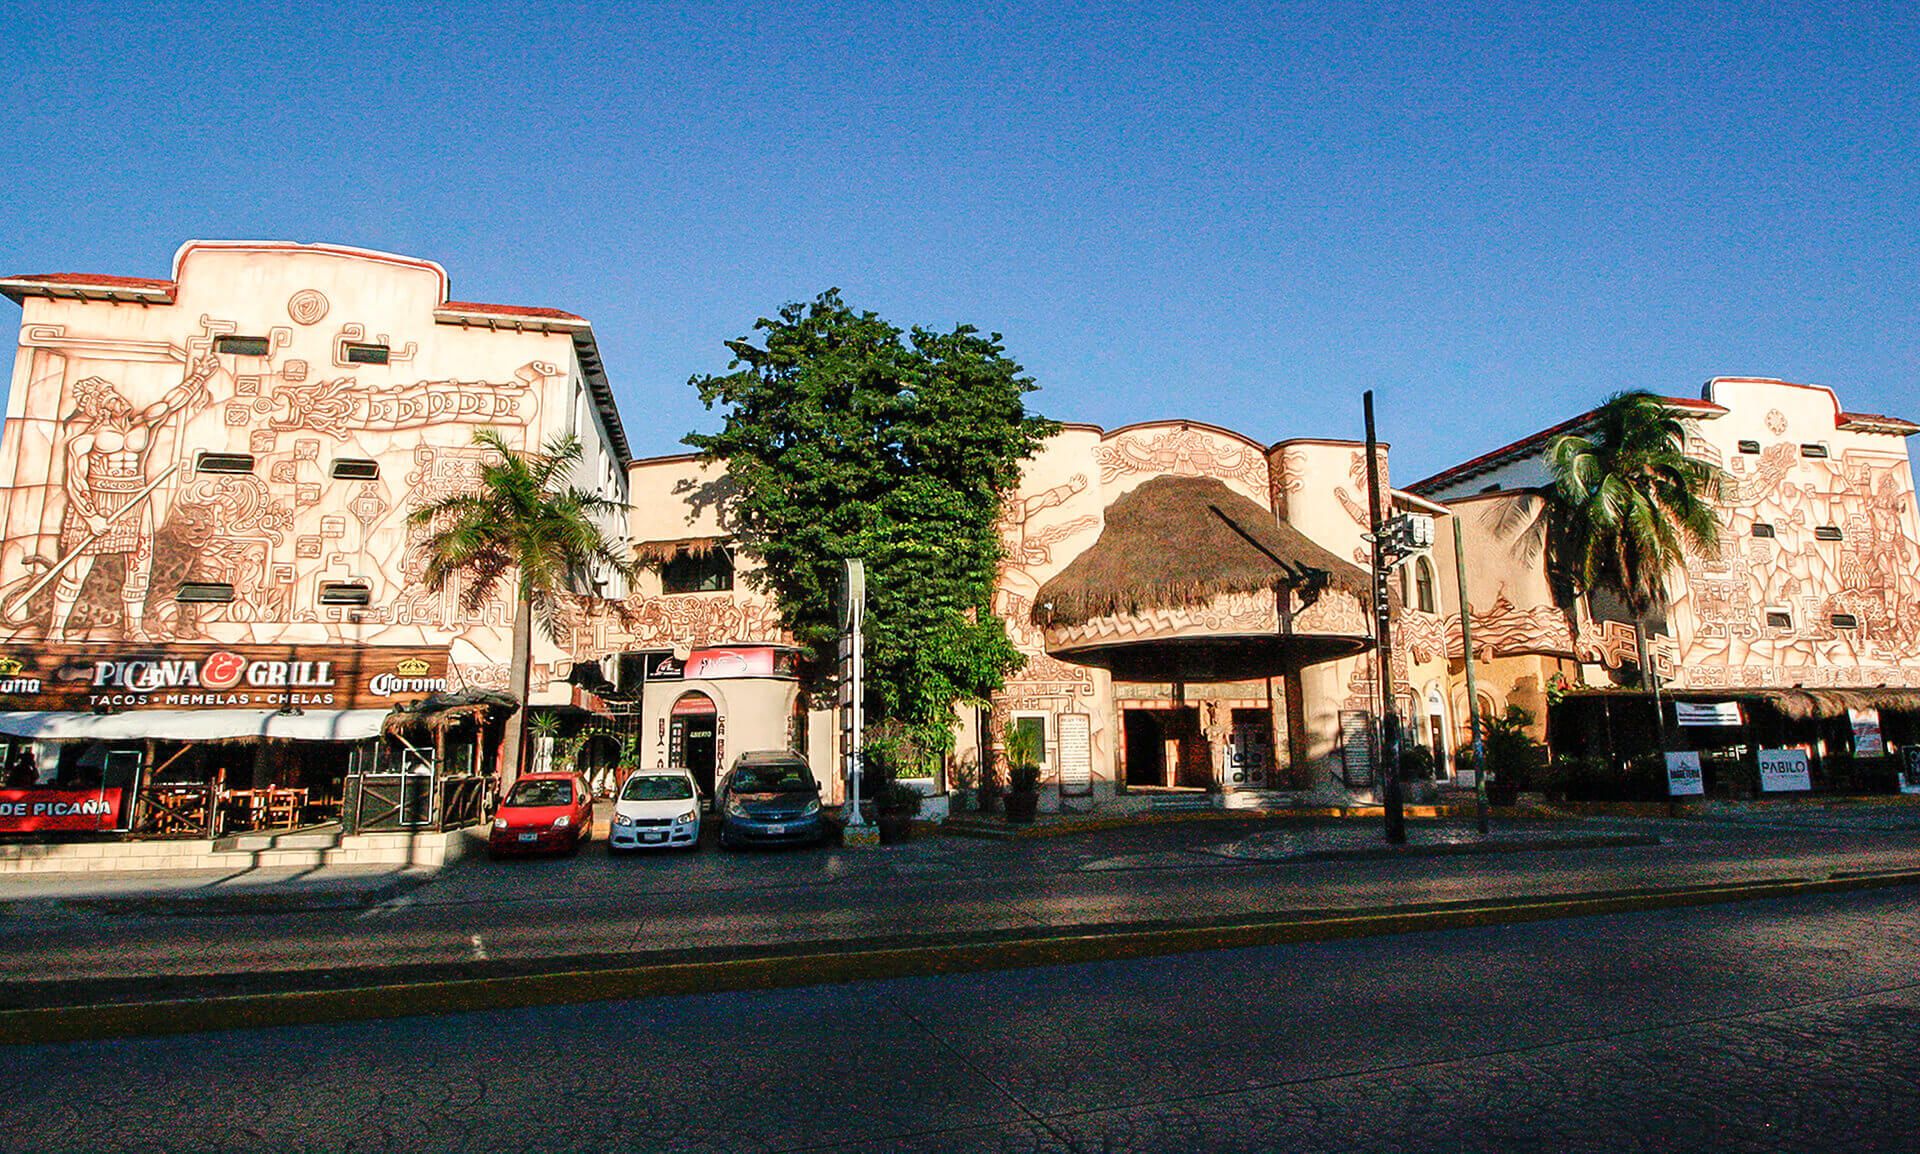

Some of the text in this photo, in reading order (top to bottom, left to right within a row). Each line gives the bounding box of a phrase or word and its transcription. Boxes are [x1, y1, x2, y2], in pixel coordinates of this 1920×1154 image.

[92, 652, 335, 692] PICAÑA & GRILL
[0, 678, 41, 694] ona
[369, 673, 449, 697] Corona
[90, 692, 334, 706] TACOS MEMELAS CHELAS
[716, 716, 726, 777] CAR RENTAL
[1761, 760, 1806, 774] PABILO
[0, 799, 112, 816] DE PICAÑA
